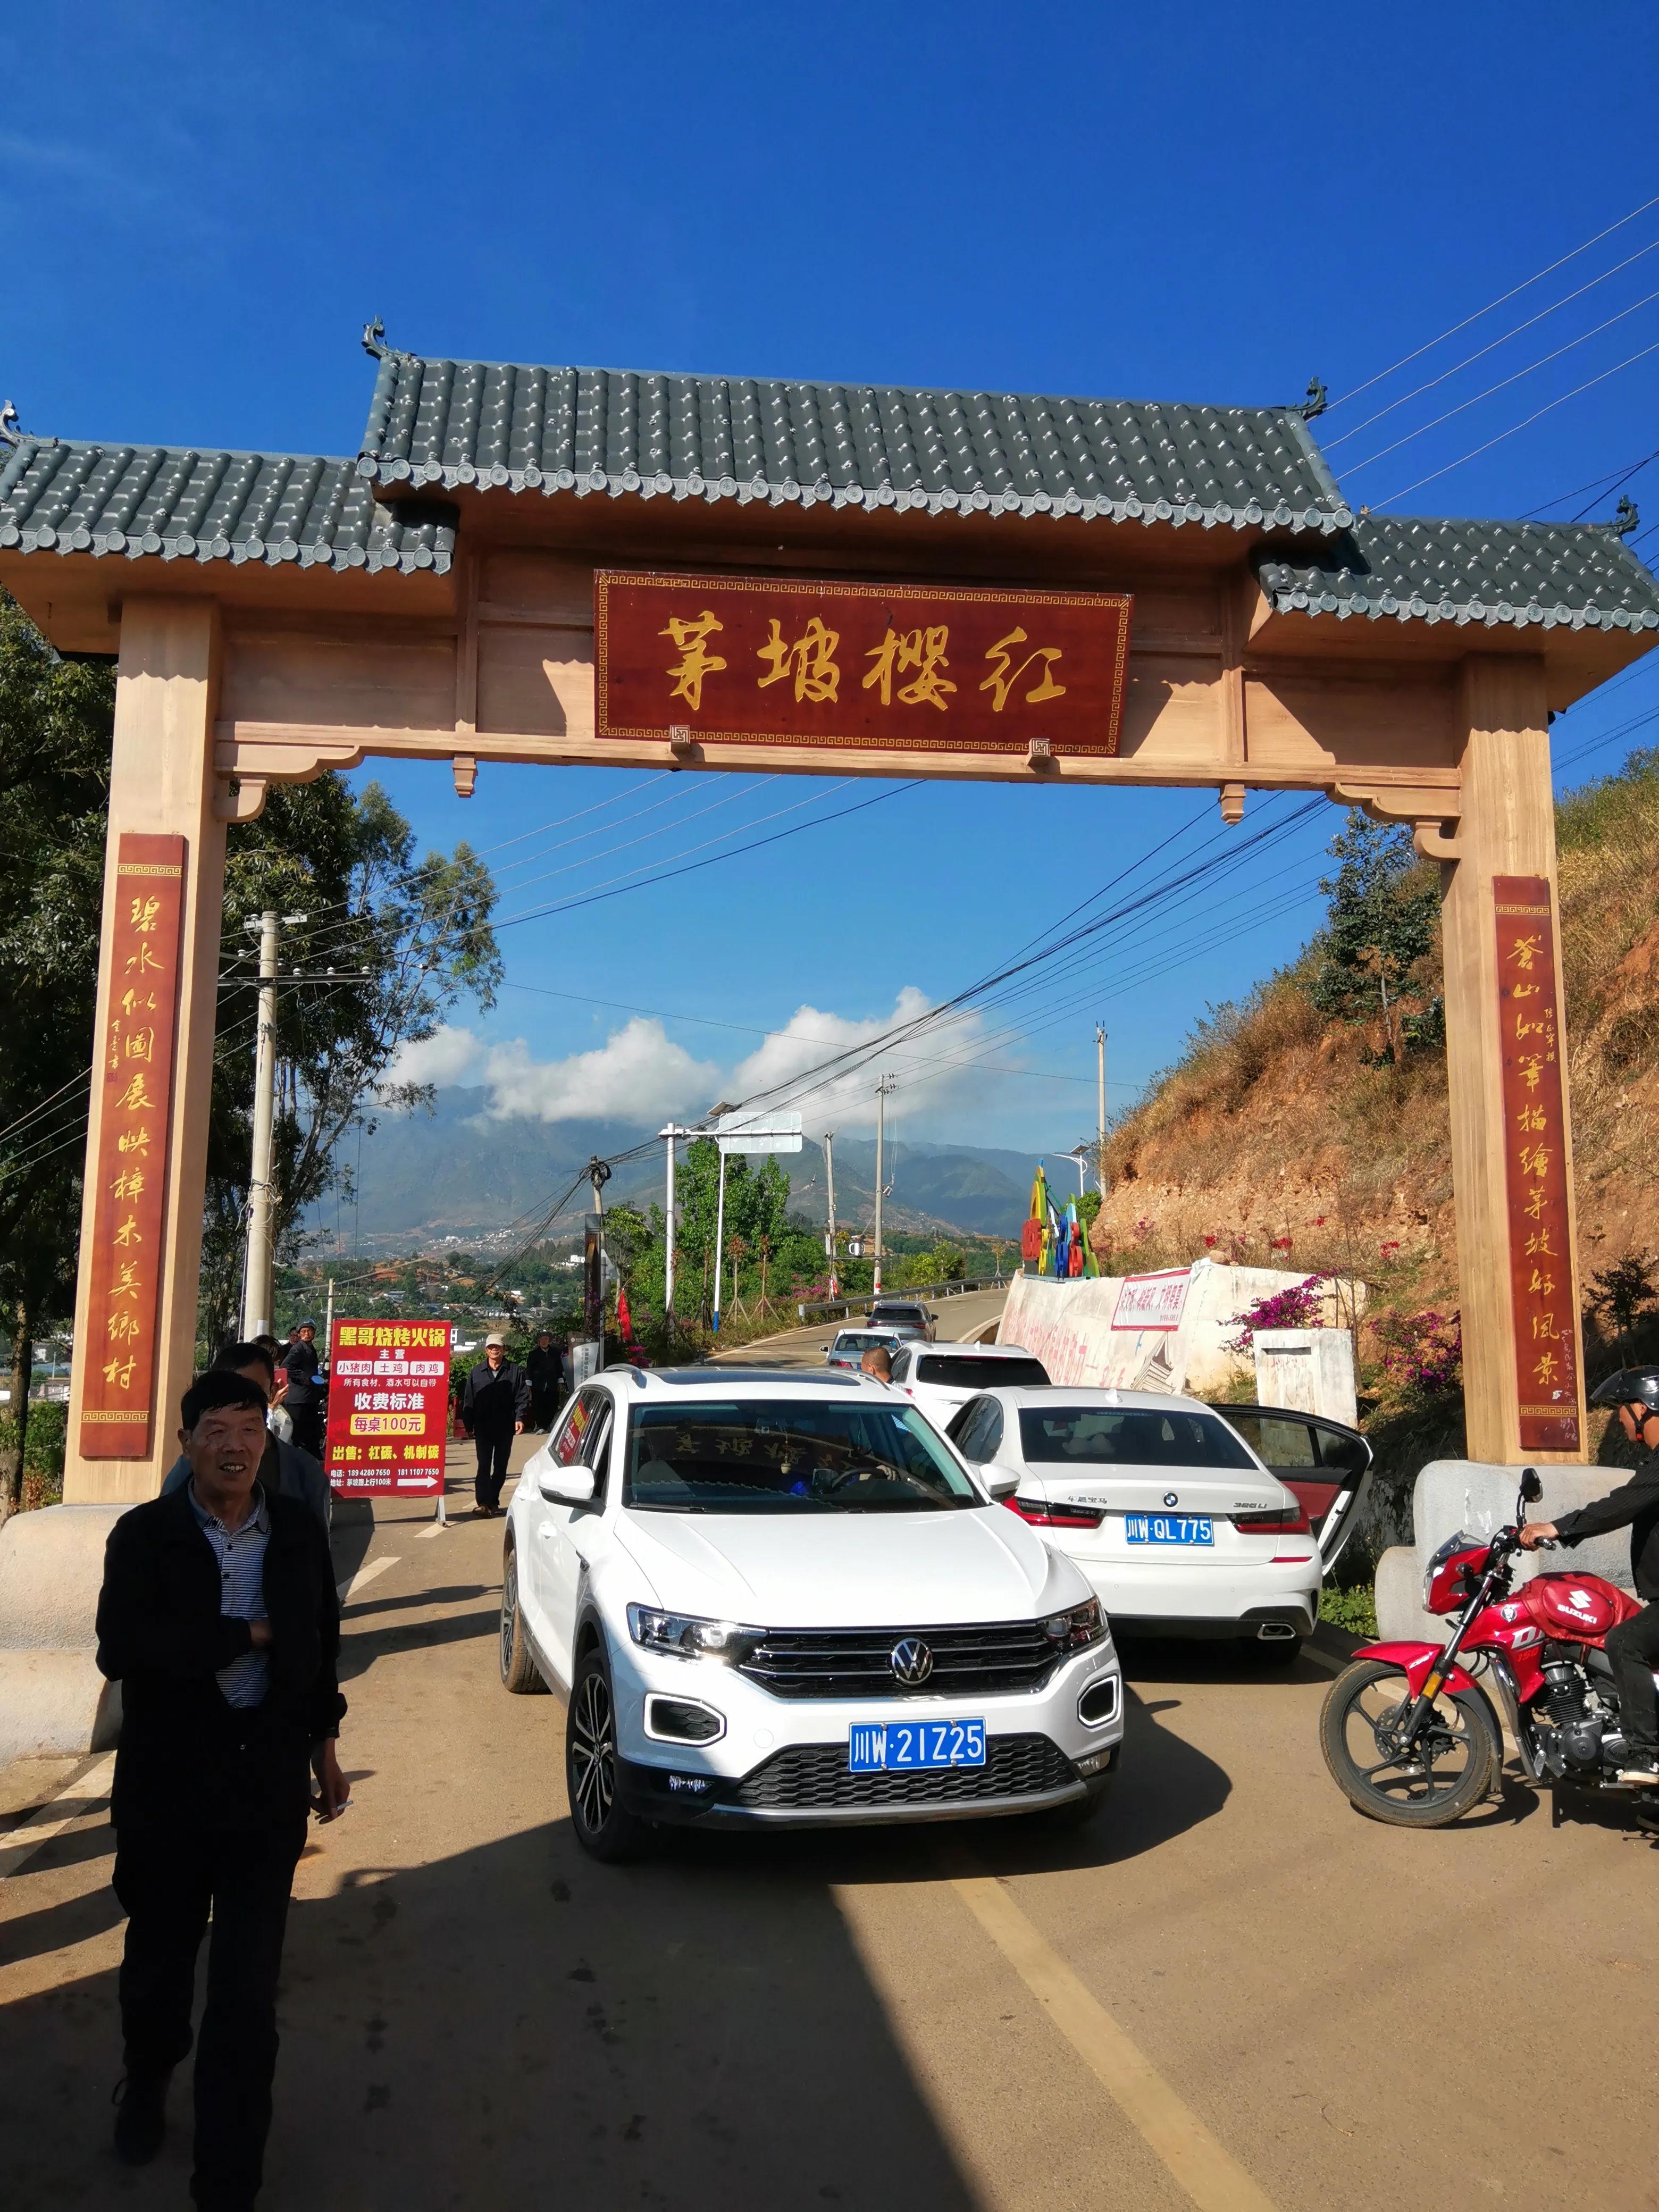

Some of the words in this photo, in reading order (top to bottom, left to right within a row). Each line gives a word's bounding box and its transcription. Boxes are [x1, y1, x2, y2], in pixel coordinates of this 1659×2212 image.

[339, 1327, 446, 1347] 黑哥烧烤火锅
[379, 1349, 405, 1360] 主营
[339, 1362, 371, 1373] 小猪肉
[379, 1363, 403, 1373] 土鸡
[416, 1363, 439, 1373] 肉鸡
[343, 1378, 437, 1387] 所有食材、酒水可以自带
[354, 1393, 424, 1410] 收费标准
[354, 1416, 422, 1432] 每桌100元
[1067, 1495, 1108, 1504] 华晨宝马
[1557, 1604, 1597, 1624] SUZUKI
